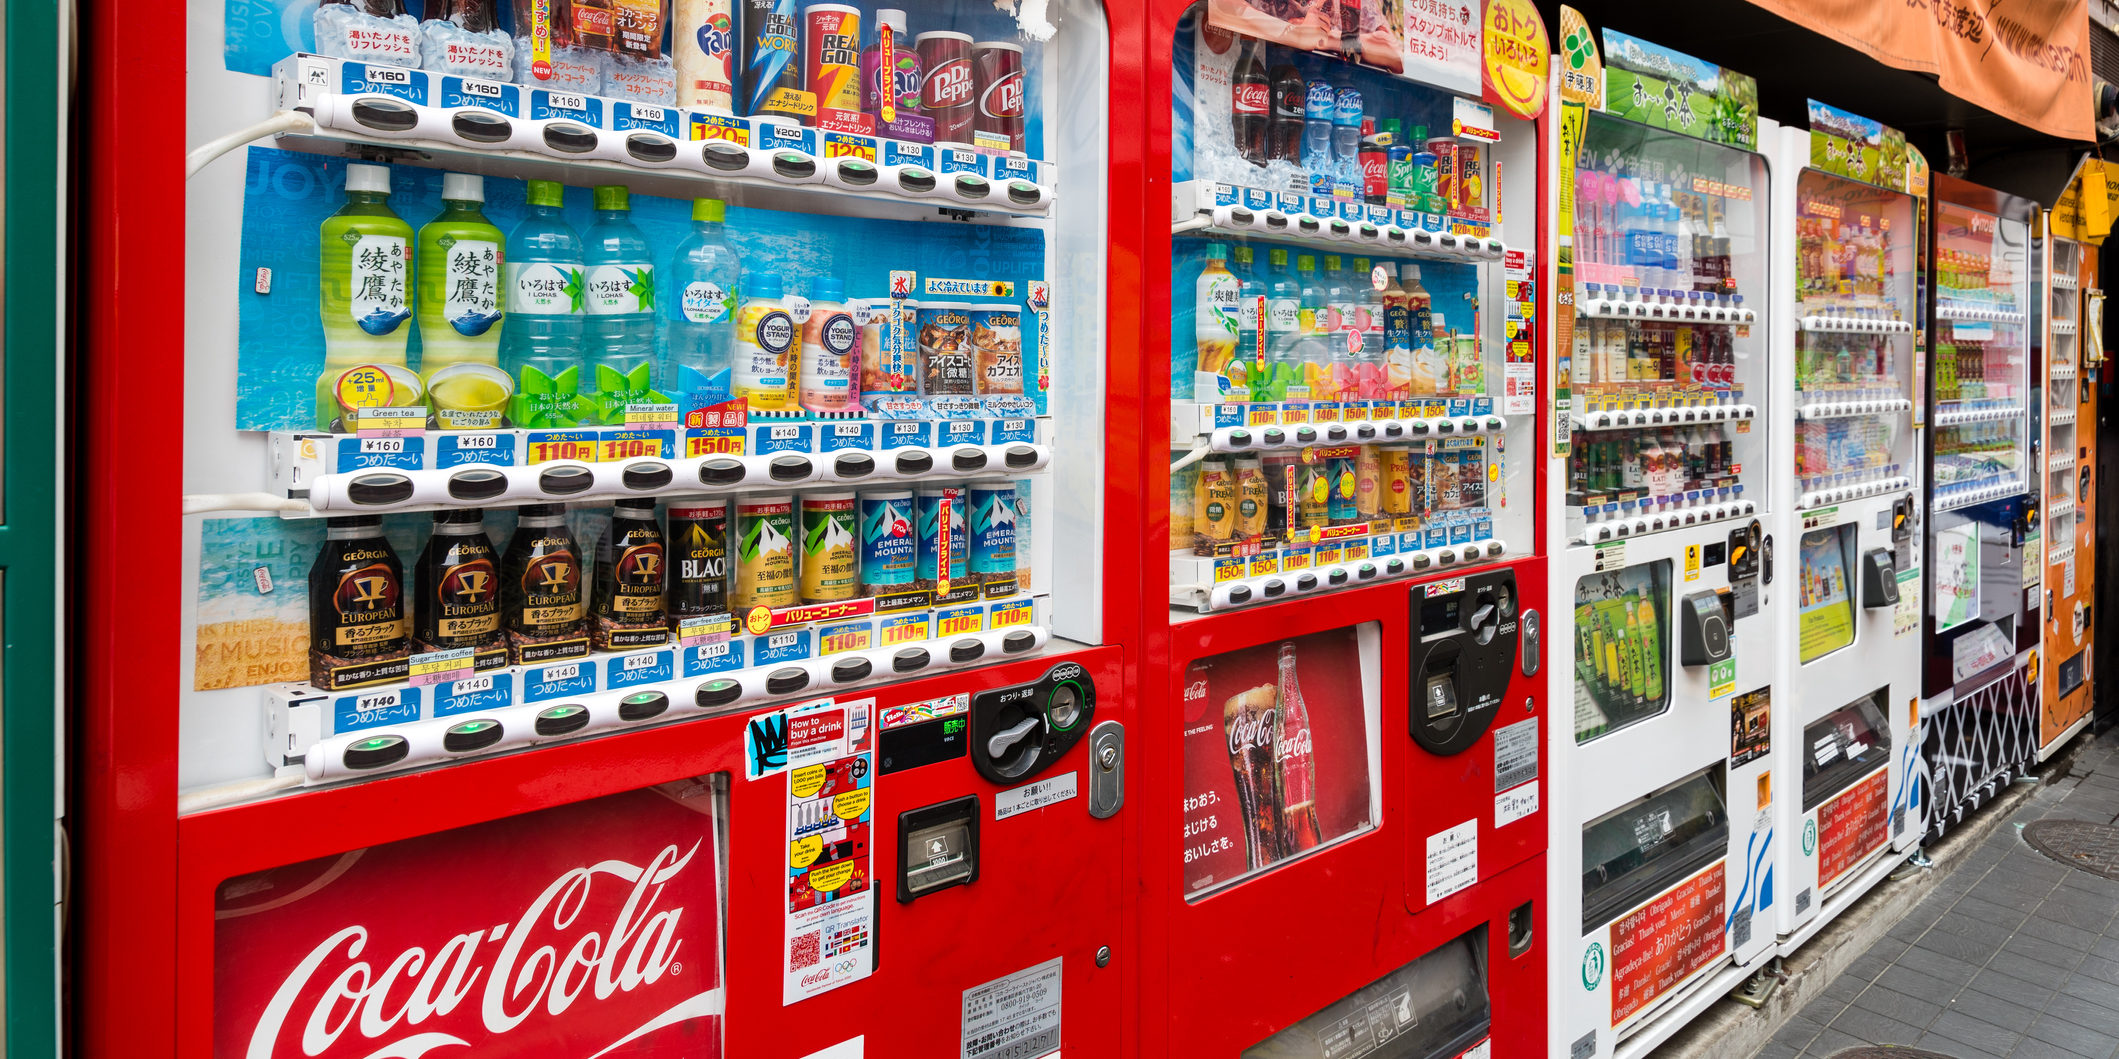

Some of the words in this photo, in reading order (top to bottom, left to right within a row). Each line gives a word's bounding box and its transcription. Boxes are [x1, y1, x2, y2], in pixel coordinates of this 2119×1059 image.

[617, 18, 657, 31] オレンジ
[1494, 5, 1536, 40] おトク
[349, 28, 410, 45] 渇いたノドを
[622, 31, 651, 42] 期間限定
[1410, 16, 1476, 49] スタンプボトルで
[350, 39, 411, 54] リフレッシュ
[447, 44, 504, 58] 渇いたノドを
[625, 41, 647, 51] 新登場
[1410, 37, 1448, 62] 伝えよう！
[1494, 35, 1538, 67] いろいろ
[448, 54, 504, 68] リフレッシュ
[882, 29, 893, 103] バリュープライス
[368, 70, 405, 82] ¥160
[533, 66, 550, 75] NEW
[950, 65, 970, 81] Dr
[614, 73, 673, 88] オレンジフレーバーの
[1565, 70, 1595, 94] 伊藤園
[350, 80, 422, 100] つめた〜い
[465, 83, 499, 96] ¥160
[552, 95, 580, 107] ¥160
[769, 99, 814, 112] エナジードリンク
[636, 108, 661, 119] ¥160
[775, 128, 800, 137] ¥200
[821, 120, 872, 134] エナジードリンク
[1466, 127, 1494, 137] バリューコーナー
[695, 126, 747, 147] 120円
[900, 145, 920, 155] ¥130
[955, 153, 974, 162] ¥130
[1008, 160, 1026, 169] ¥130
[355, 247, 390, 303] 綾鷹
[390, 241, 403, 309] あやたか
[449, 251, 482, 304] 綾鷹
[483, 247, 494, 310] あやたか
[520, 279, 566, 291] いろはす
[590, 280, 632, 292] いろはす
[894, 277, 907, 293] 氷
[928, 281, 989, 294] よく冷えています
[687, 299, 720, 308] サイダー
[1273, 308, 1298, 318] いろはす
[356, 384, 376, 392] 増量
[539, 392, 570, 400] おいしい
[530, 402, 579, 411] 日本の天然水
[630, 404, 654, 412] Mineral
[726, 404, 745, 412] NEW!
[886, 401, 922, 410] 甘さすっきり
[937, 401, 979, 411] 甘さすっきり微糖
[987, 401, 1034, 409] ミルクのやさしいコク
[1426, 405, 1445, 417] 150円
[372, 408, 399, 417] Green
[401, 409, 415, 417] tea
[1252, 411, 1274, 424] 110円
[1285, 410, 1306, 422] 110円
[1316, 409, 1337, 421] 140円
[1345, 408, 1366, 419] 150円
[1373, 407, 1393, 418] 150円
[1401, 406, 1420, 418] 150円
[688, 412, 744, 427] 新製品！
[1005, 421, 1023, 430] ¥130
[775, 428, 797, 437] ¥140
[838, 426, 859, 434] ¥140
[896, 424, 917, 432] ¥130
[952, 423, 971, 432] ¥130
[462, 437, 494, 447] ¥160
[545, 432, 583, 441] つめた〜い
[614, 431, 649, 440] つめた〜い
[366, 440, 400, 450] ¥160
[536, 442, 590, 461] 110円
[605, 440, 656, 458] 110円
[693, 437, 741, 455] 150円
[452, 450, 515, 463] つめた〜い
[1319, 448, 1353, 457] バリューコーナー
[1326, 527, 1361, 538] バリューコーナー
[940, 506, 949, 576] バリュープライス
[1286, 556, 1307, 568] 110円
[1319, 551, 1339, 563] 110円
[1217, 565, 1244, 579] 150円
[1251, 561, 1277, 574] 150円
[702, 584, 719, 593] 無糖
[528, 592, 577, 606] EUROPEAN
[444, 601, 495, 616] EUROPEAN
[531, 607, 574, 619] 香るブラック
[785, 604, 857, 622] バリューコーナー
[341, 607, 396, 624] EUROPEAN
[749, 612, 769, 624] おトク
[447, 617, 493, 630] 香るブラック
[345, 623, 395, 638] 香るブラック
[772, 635, 794, 645] ¥110
[410, 653, 449, 664] Sugar-free
[451, 650, 473, 660] coffee
[524, 645, 585, 659] 豊かな香り・上質な苦味
[701, 646, 725, 656] ¥110
[760, 645, 807, 659] つめた〜い
[628, 655, 654, 667] ¥140
[691, 655, 741, 671] つめた〜い
[338, 665, 408, 682] 豊かな香り・上質な苦味
[547, 667, 576, 678] ¥140
[457, 679, 489, 690] ¥140
[533, 678, 592, 695] つめた〜い
[362, 695, 395, 708] ¥140
[345, 704, 416, 724] つめた〜い
[886, 711, 904, 723] Hello
[791, 720, 809, 730] How
[791, 729, 809, 740] buy
[810, 727, 817, 735] a
[818, 722, 842, 734] drink
[944, 719, 966, 735] 販売中
[1196, 724, 1213, 733] FEELING
[1275, 728, 1312, 763] Coca-Cola
[1184, 836, 1234, 863] おいしさを。
[1650, 897, 1673, 917] Obrigado
[1676, 882, 1695, 901] Gracias!
[1698, 873, 1713, 888] Thank
[1713, 865, 1724, 882] you!
[1613, 935, 1635, 956] Gracias!
[1638, 924, 1654, 941] Thank
[1655, 917, 1667, 935] you!
[1670, 904, 1686, 922] Merci!
[1705, 883, 1721, 900] Danke!
[245, 835, 703, 1059] Coca-Cola
[1614, 945, 1654, 982] Agradeça-lhe!
[1655, 919, 1691, 956] ありがとう
[1693, 910, 1712, 930] Gracias!
[1633, 970, 1652, 991] Danke!
[1703, 925, 1724, 944] Obrigado
[1613, 999, 1639, 1022] Obrigado
[1658, 976, 1674, 992] Thank
[1674, 964, 1685, 984] you!
[1690, 941, 1721, 969] Agradeça-lhe!
